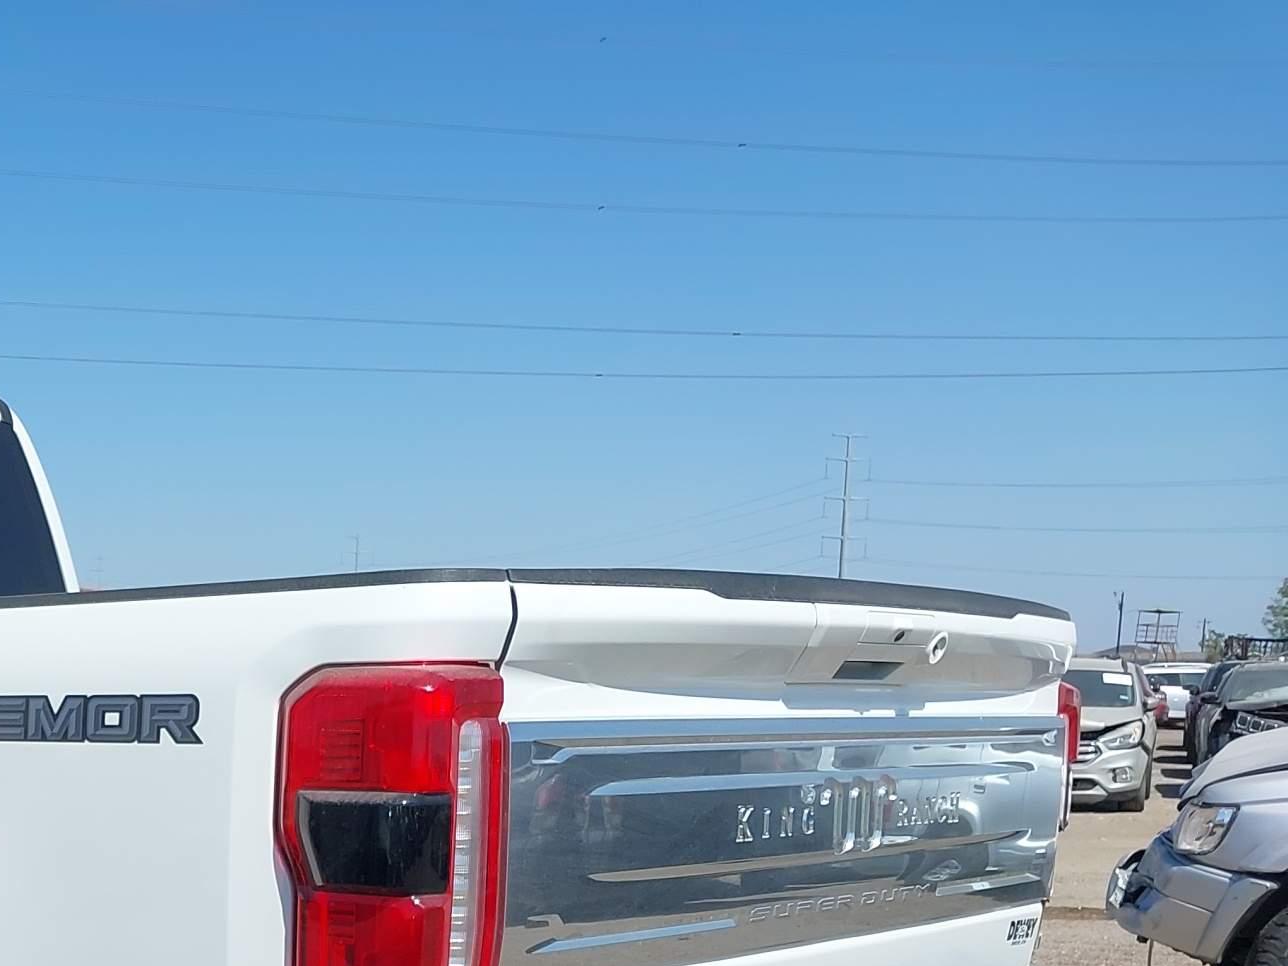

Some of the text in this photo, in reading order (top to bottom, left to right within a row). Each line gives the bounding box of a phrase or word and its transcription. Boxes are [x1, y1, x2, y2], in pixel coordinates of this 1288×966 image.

[735, 791, 961, 843] KING RANCH
[749, 882, 931, 923] SUPER DUTY
